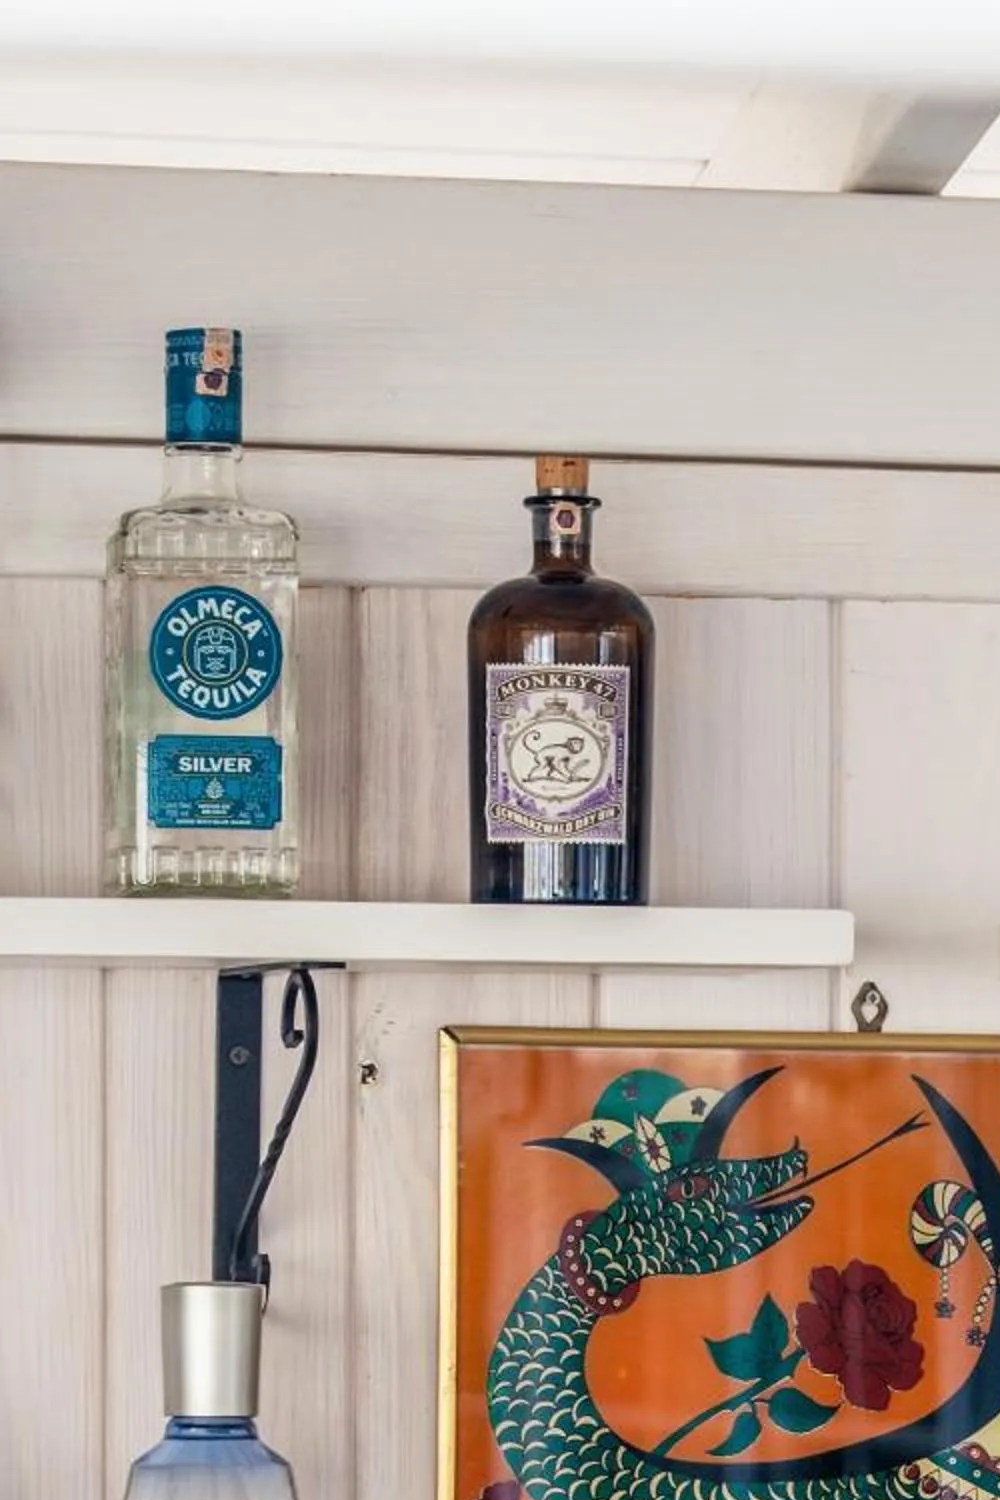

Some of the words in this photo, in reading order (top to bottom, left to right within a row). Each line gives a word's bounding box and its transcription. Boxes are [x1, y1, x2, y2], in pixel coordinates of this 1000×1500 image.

[167, 598, 263, 640] OLMECA
[167, 664, 267, 709] TEQUILA
[501, 674, 590, 697] MONKEY
[594, 681, 613, 697] 47
[179, 756, 252, 773] SILVER
